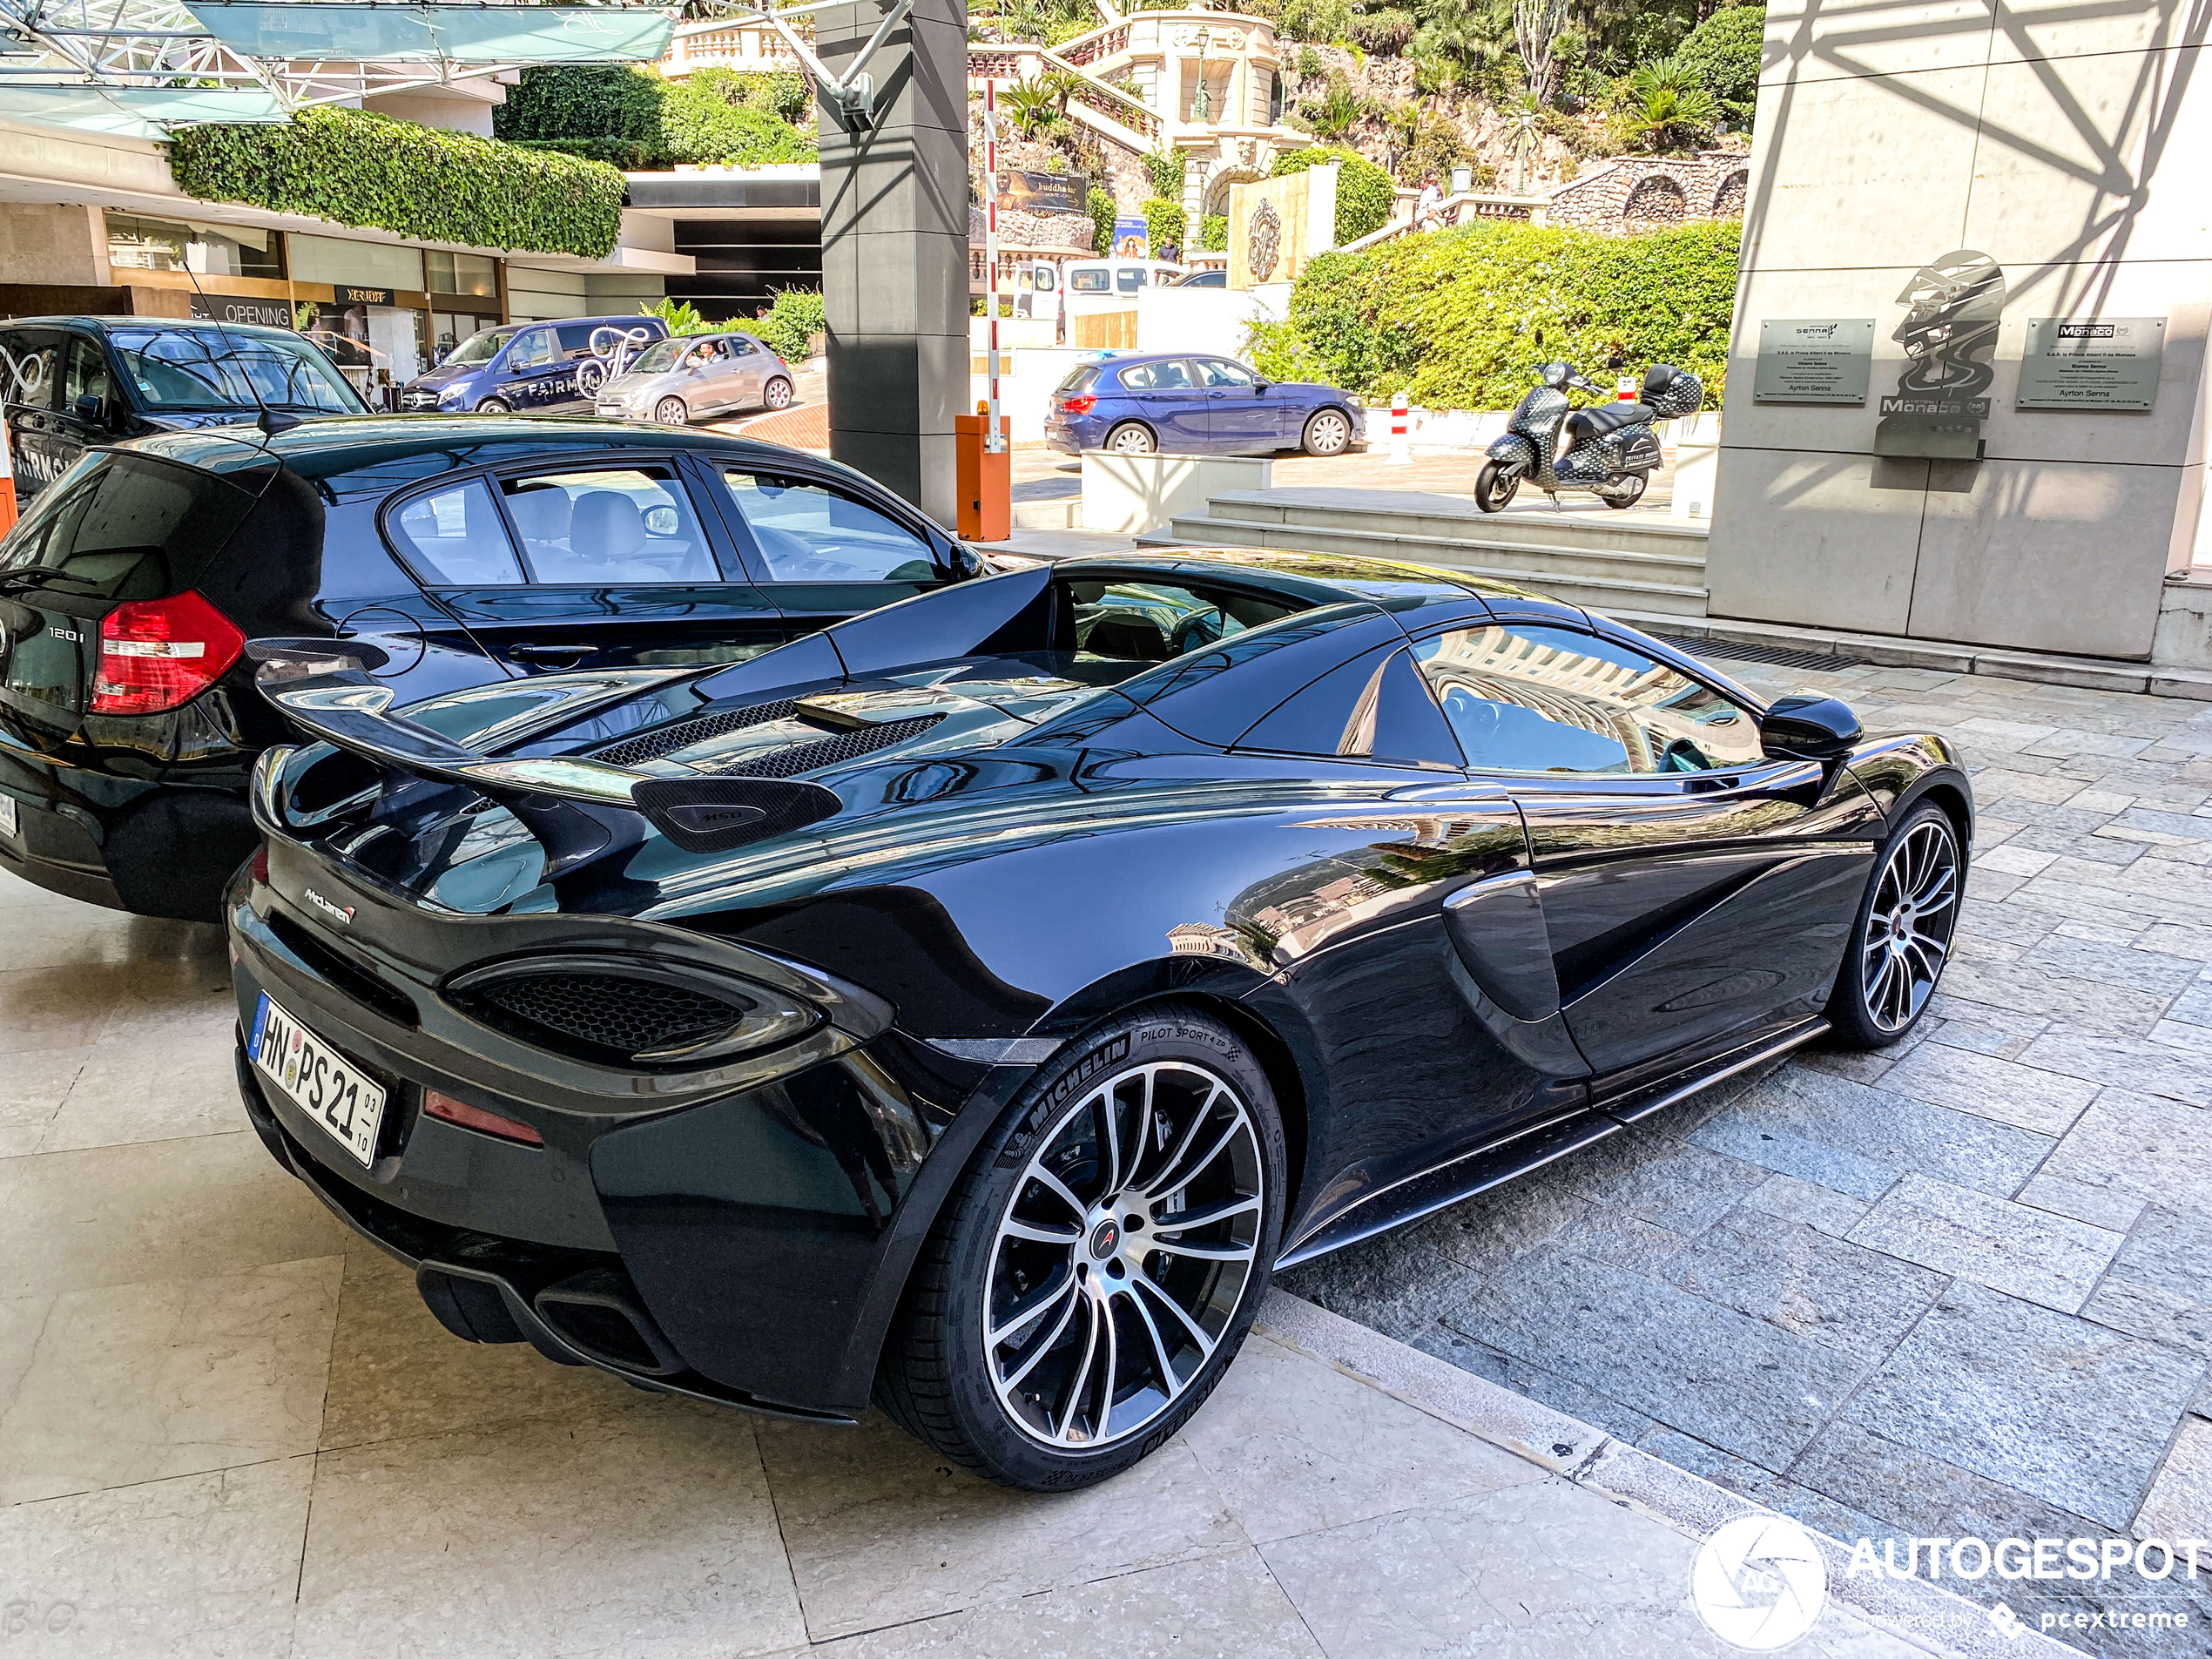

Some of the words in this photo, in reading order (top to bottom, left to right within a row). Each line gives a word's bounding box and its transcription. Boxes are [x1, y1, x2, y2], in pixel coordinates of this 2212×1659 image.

[226, 304, 289, 326] OPENING
[2060, 326, 2113, 336] Monaco
[2059, 389, 2083, 398] Ayrton
[1882, 399, 1961, 414] Monaco
[304, 888, 351, 925] McLaren
[260, 1009, 290, 1077] HN
[1141, 1028, 1173, 1042] PILOT
[1175, 1028, 1211, 1042] SPORT
[1216, 1038, 1226, 1048] ZP
[1029, 1038, 1127, 1131] MICHELIN
[364, 1093, 376, 1113] 03
[358, 1132, 368, 1152] 10
